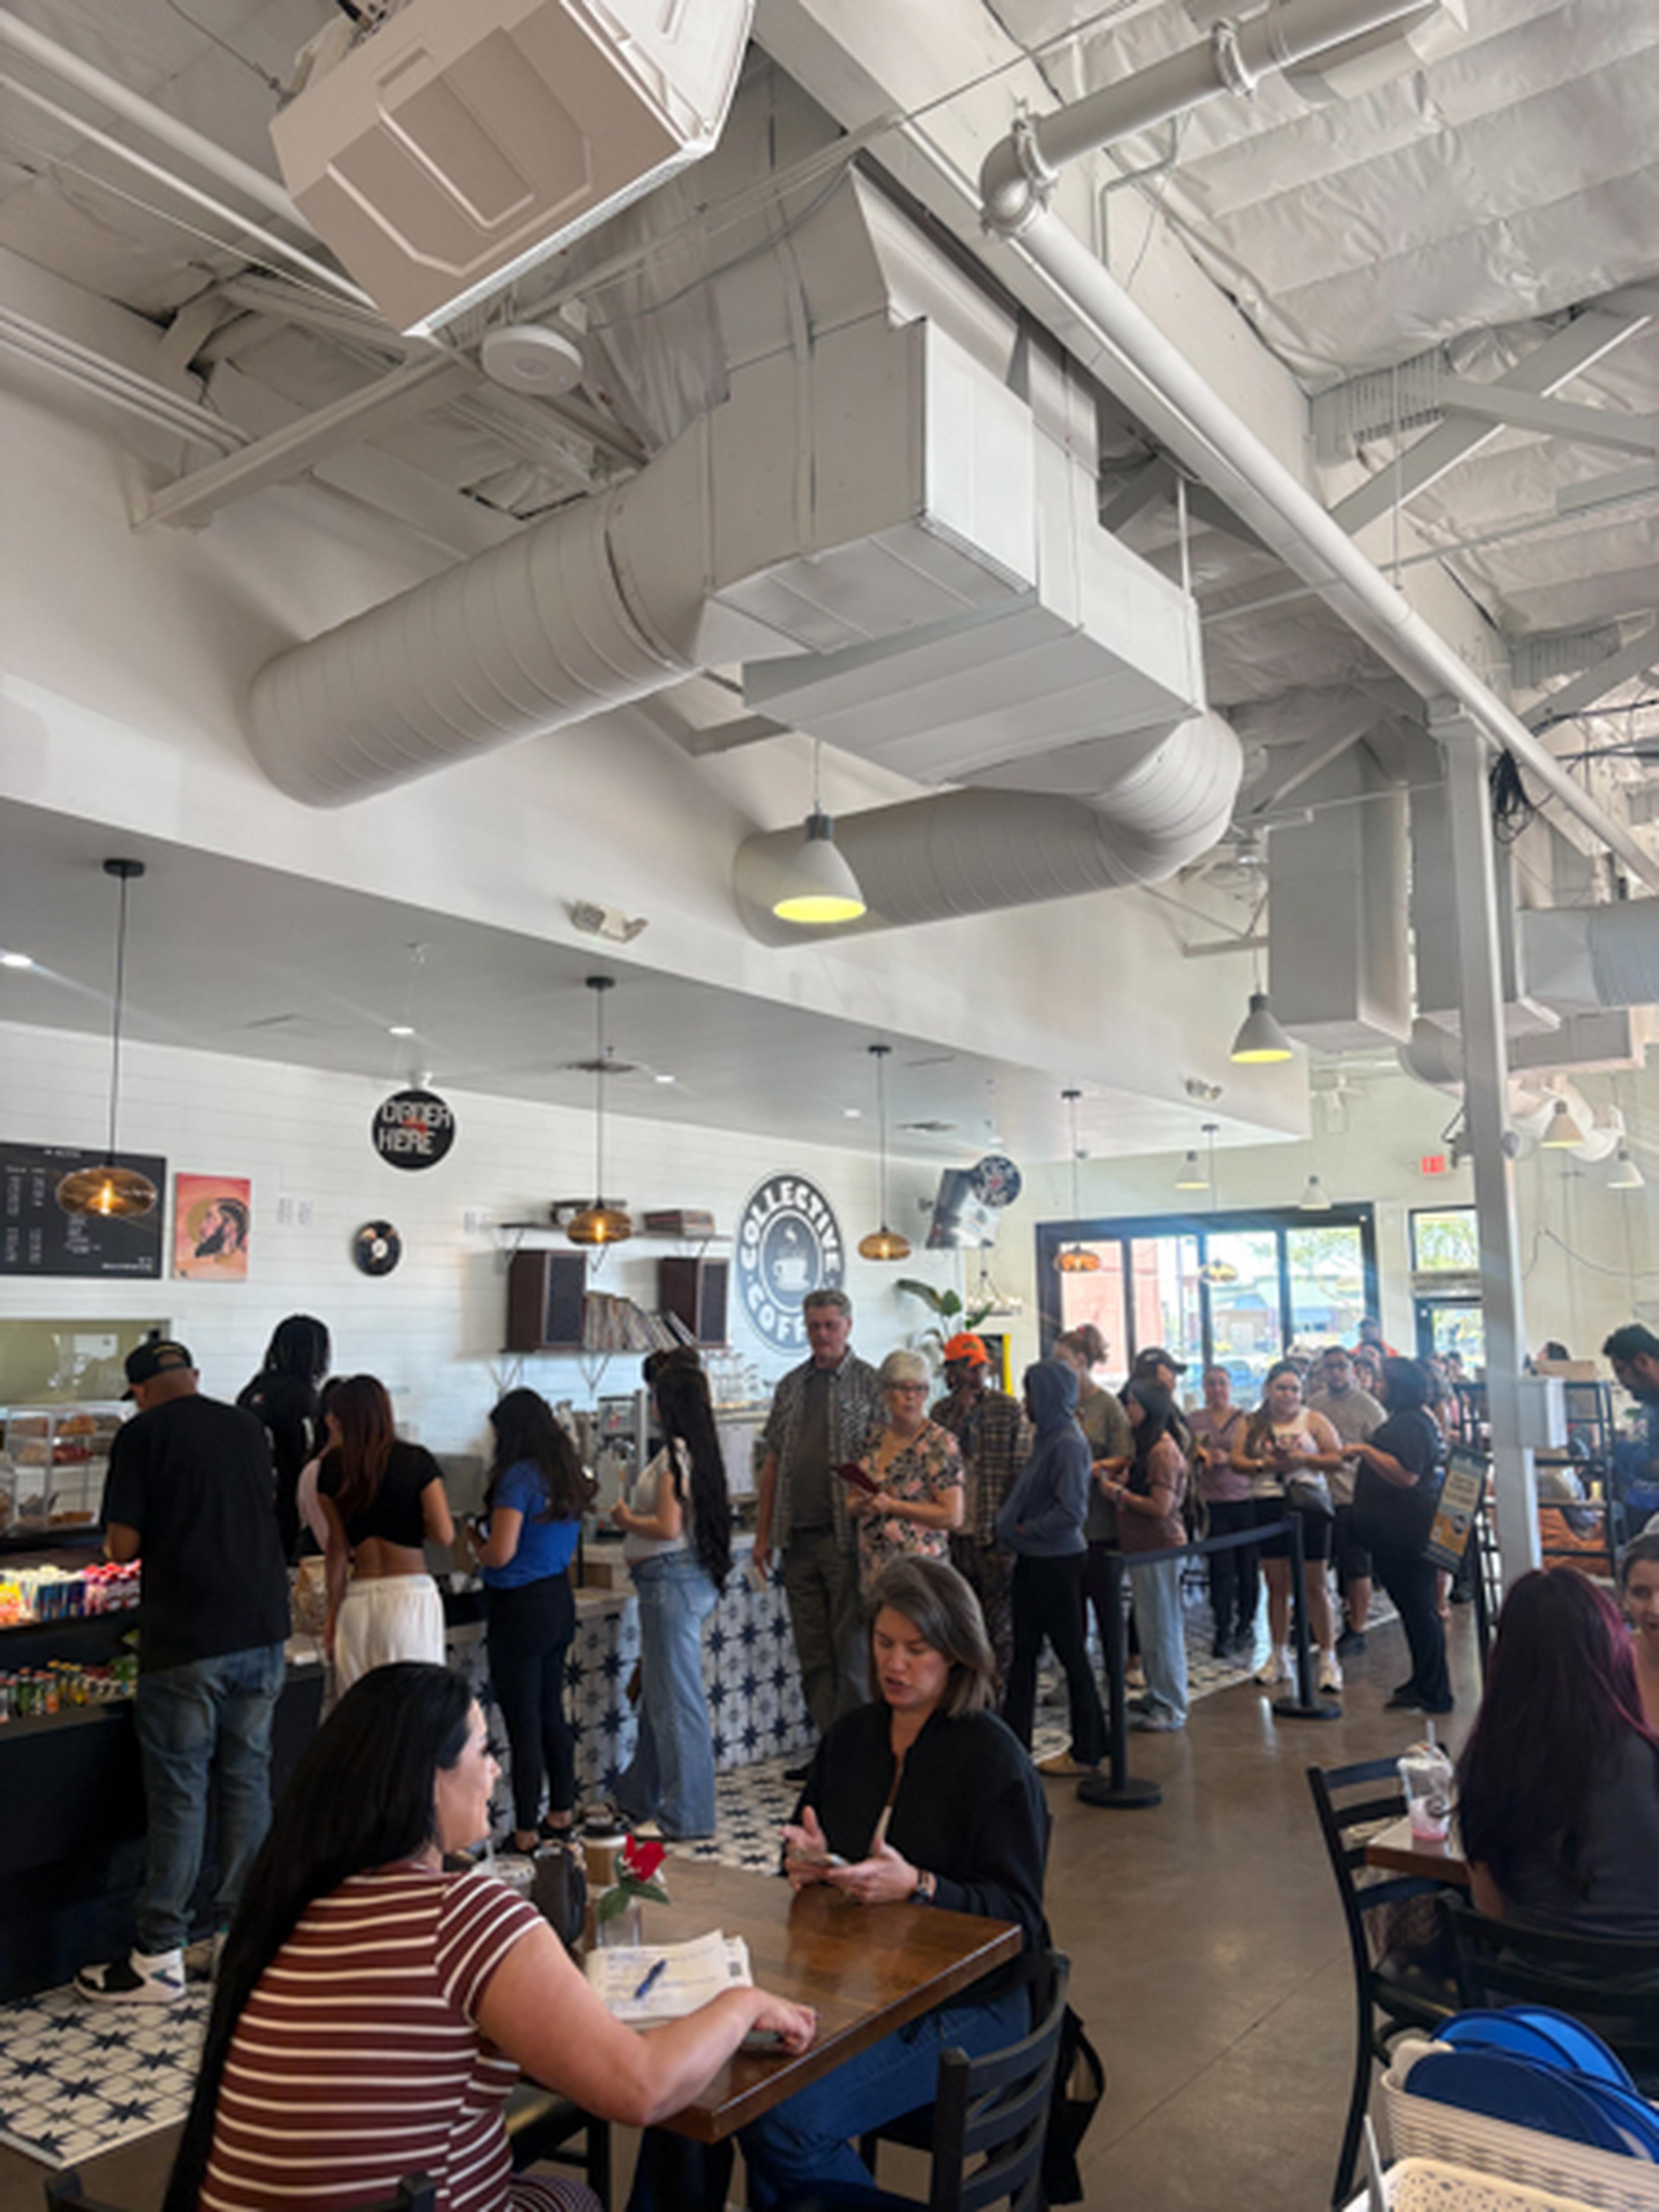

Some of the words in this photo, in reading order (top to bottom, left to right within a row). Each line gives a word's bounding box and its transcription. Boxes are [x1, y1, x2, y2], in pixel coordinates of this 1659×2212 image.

[381, 1102, 451, 1129] ORDER
[378, 1127, 436, 1154] HERE
[1421, 1154, 1446, 1175] EXIT
[740, 1181, 842, 1273] COLLECTIVE
[747, 1281, 807, 1344] COFF
